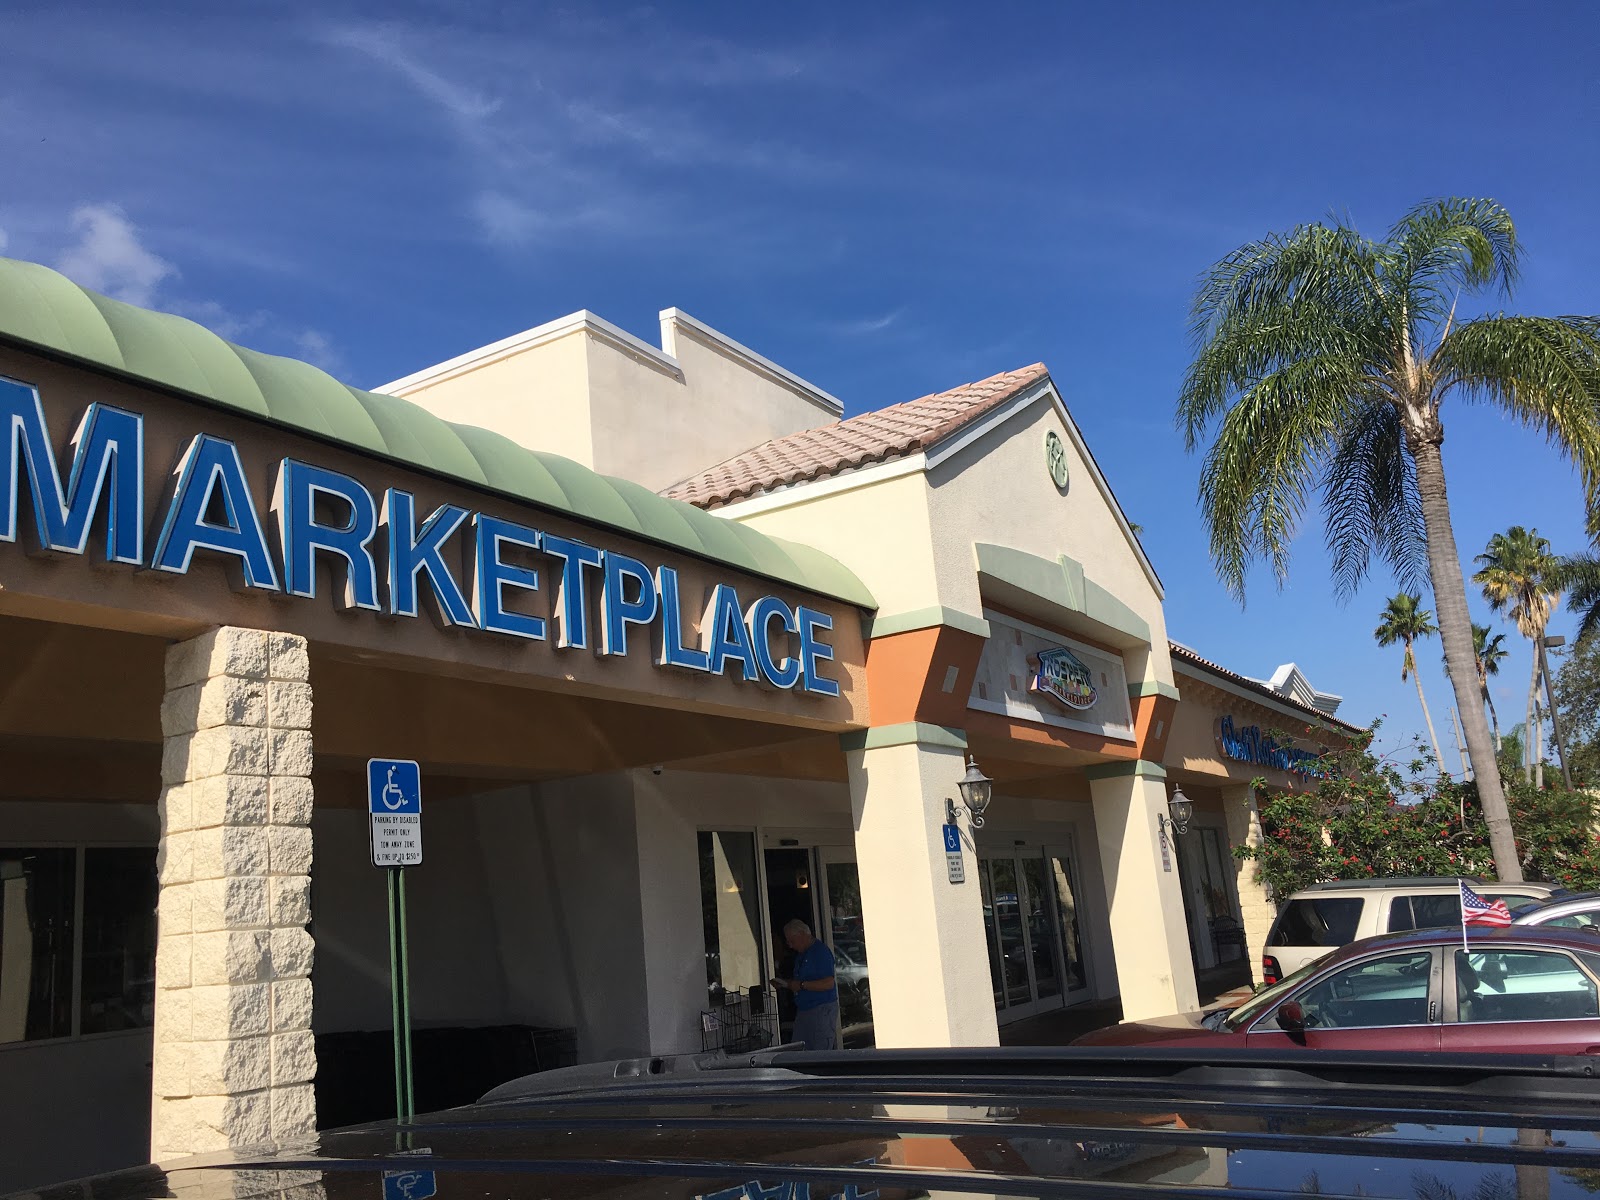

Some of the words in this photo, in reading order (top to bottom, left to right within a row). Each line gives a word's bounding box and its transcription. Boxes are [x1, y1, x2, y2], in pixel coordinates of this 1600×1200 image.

[0, 374, 840, 697] MARKETPLACE
[374, 816, 392, 824] PARKING
[392, 816, 399, 824] BY
[399, 816, 419, 824] DISABLED
[383, 828, 398, 836] PERMIT
[399, 828, 410, 836] ONLY
[380, 841, 389, 849] TOW
[404, 840, 415, 848] ZONE
[381, 853, 391, 861] FINE
